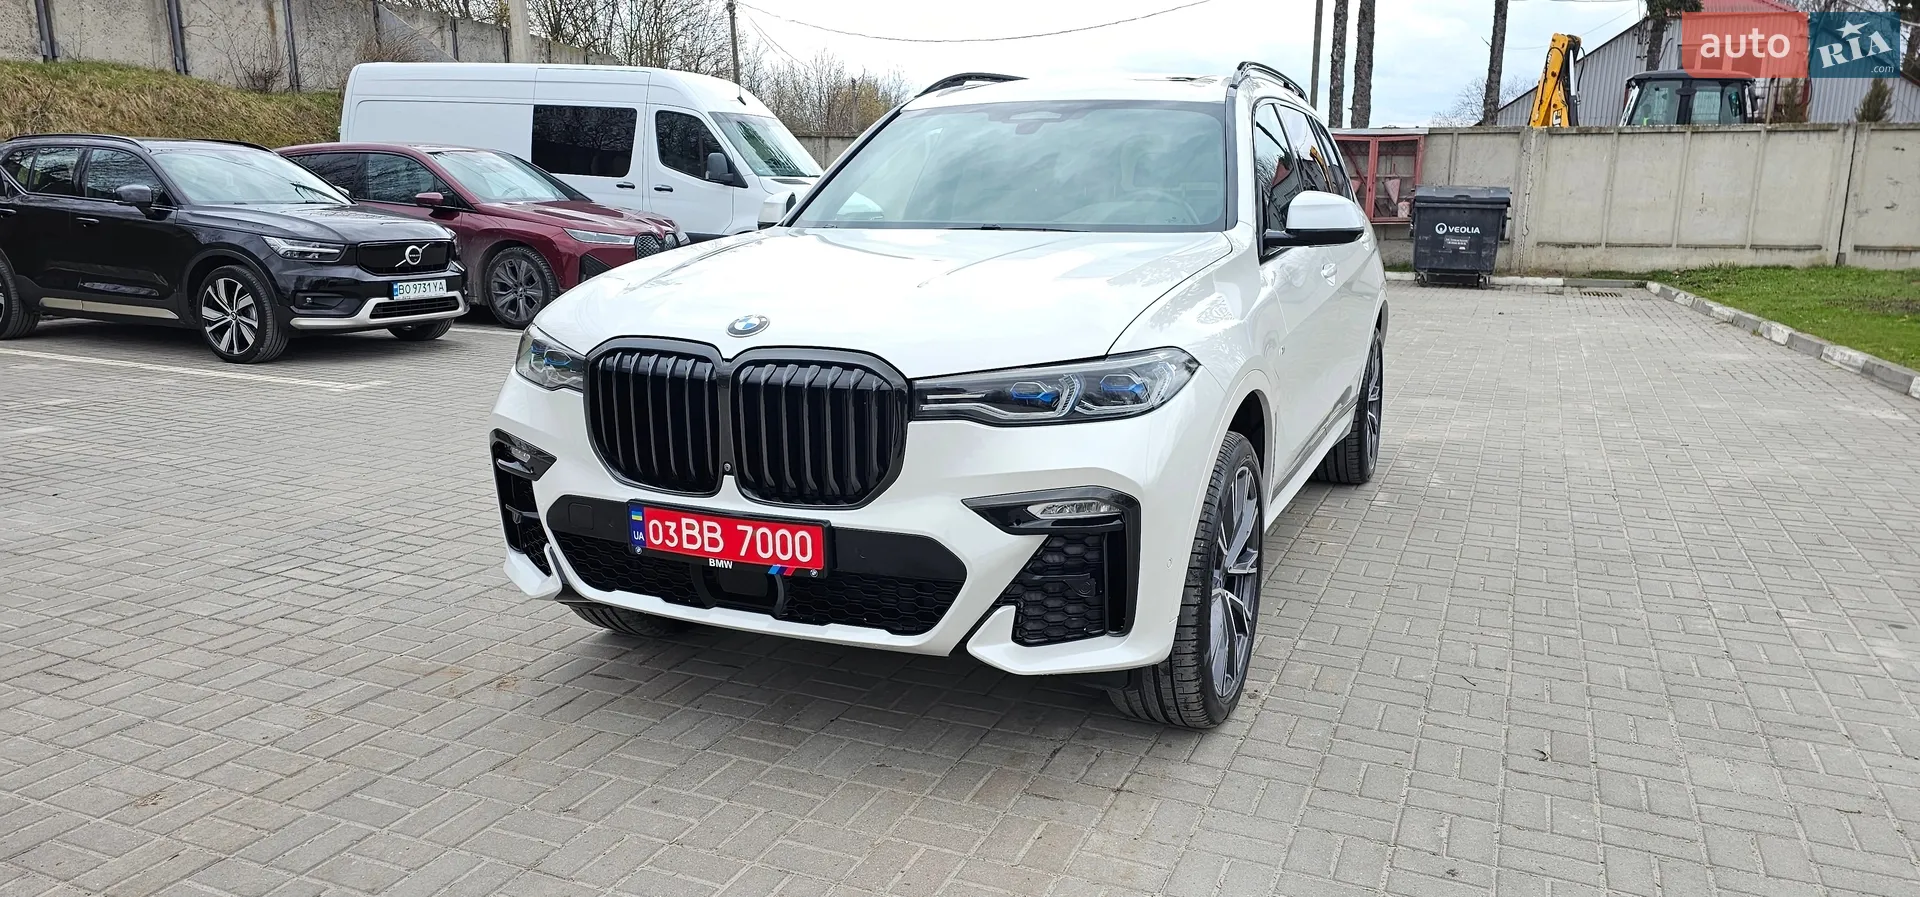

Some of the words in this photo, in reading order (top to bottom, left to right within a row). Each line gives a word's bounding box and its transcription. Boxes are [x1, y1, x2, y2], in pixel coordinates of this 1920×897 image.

[399, 284, 410, 294] BO
[412, 282, 431, 293] 9731
[433, 282, 444, 291] YA
[633, 530, 645, 541] UA
[736, 524, 813, 563] 7000
[708, 557, 733, 570] BMW
